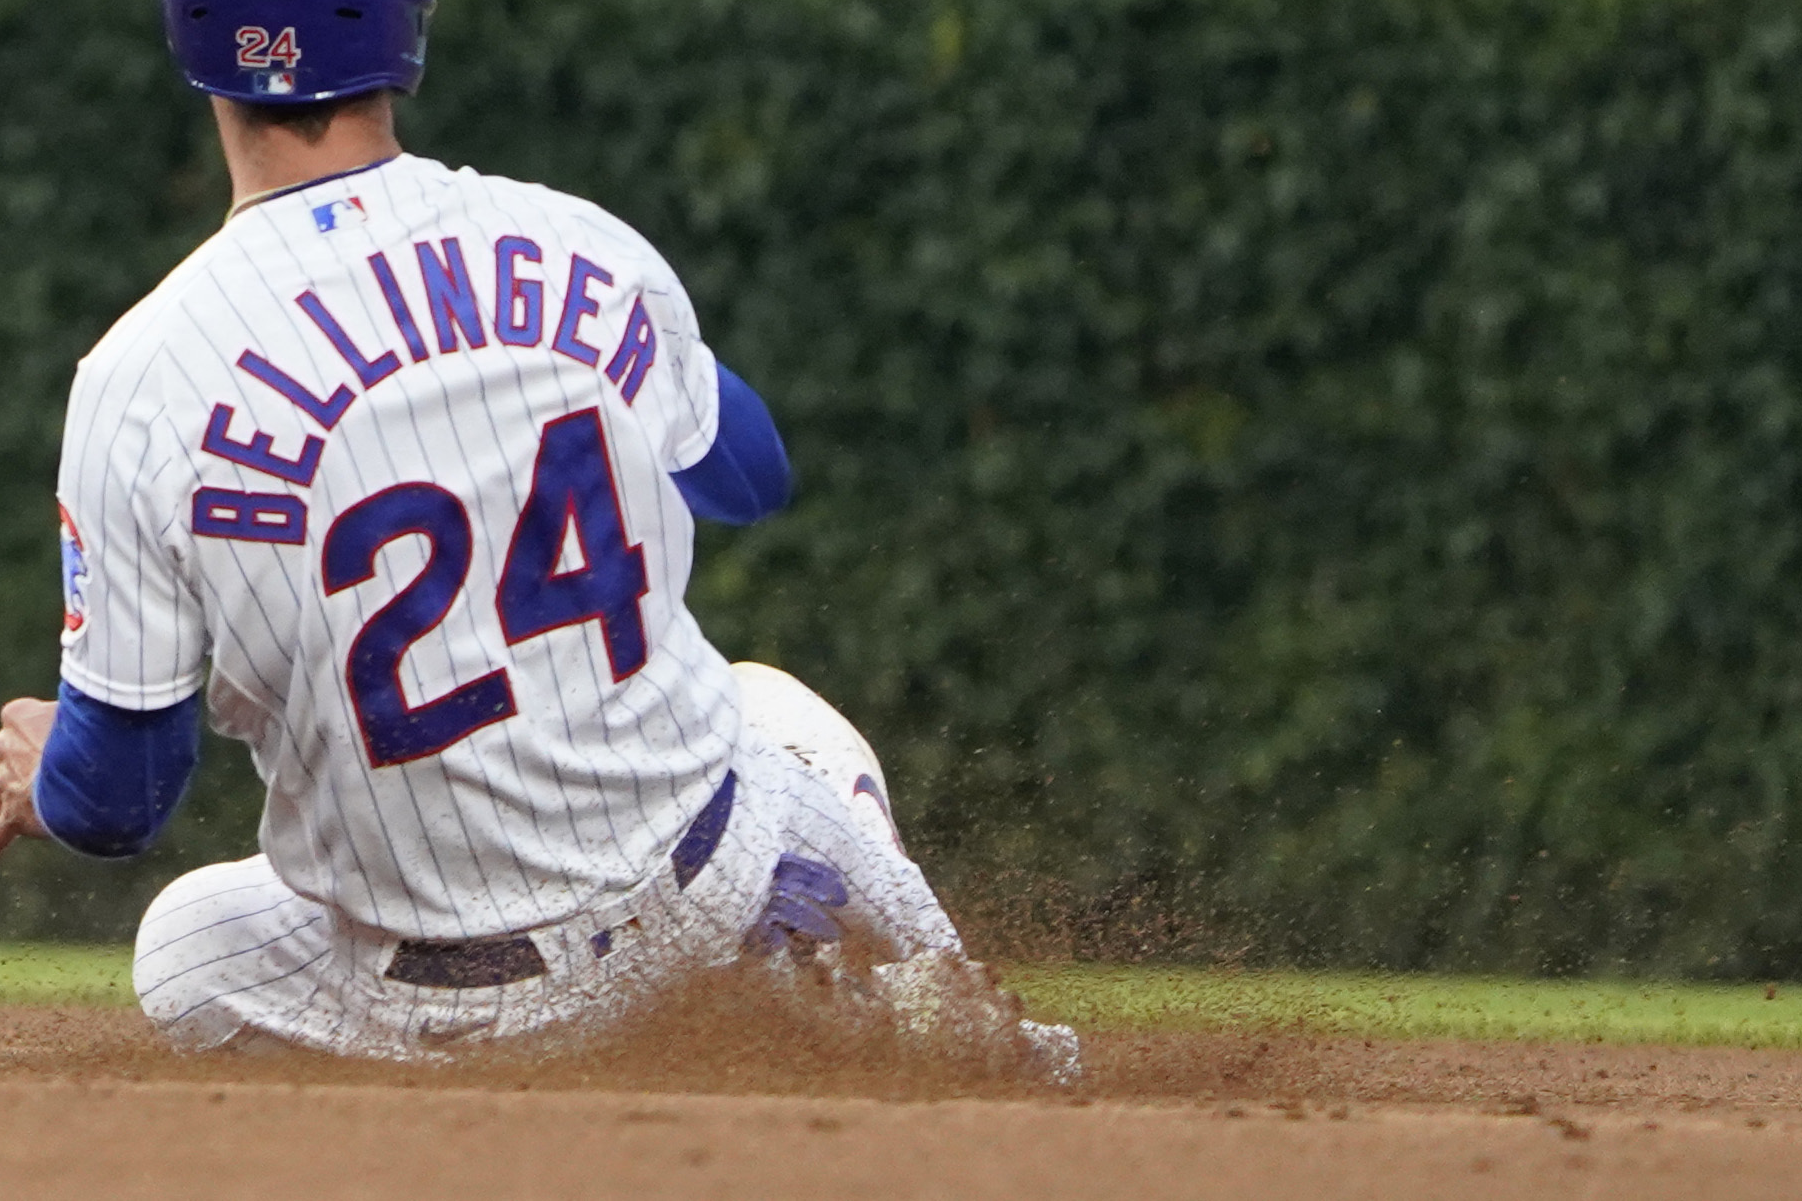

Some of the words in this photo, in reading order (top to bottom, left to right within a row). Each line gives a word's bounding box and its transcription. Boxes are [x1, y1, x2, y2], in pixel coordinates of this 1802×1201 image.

[235, 25, 302, 68] 24
[192, 235, 656, 546] BELLINGER
[322, 405, 649, 769] 24
